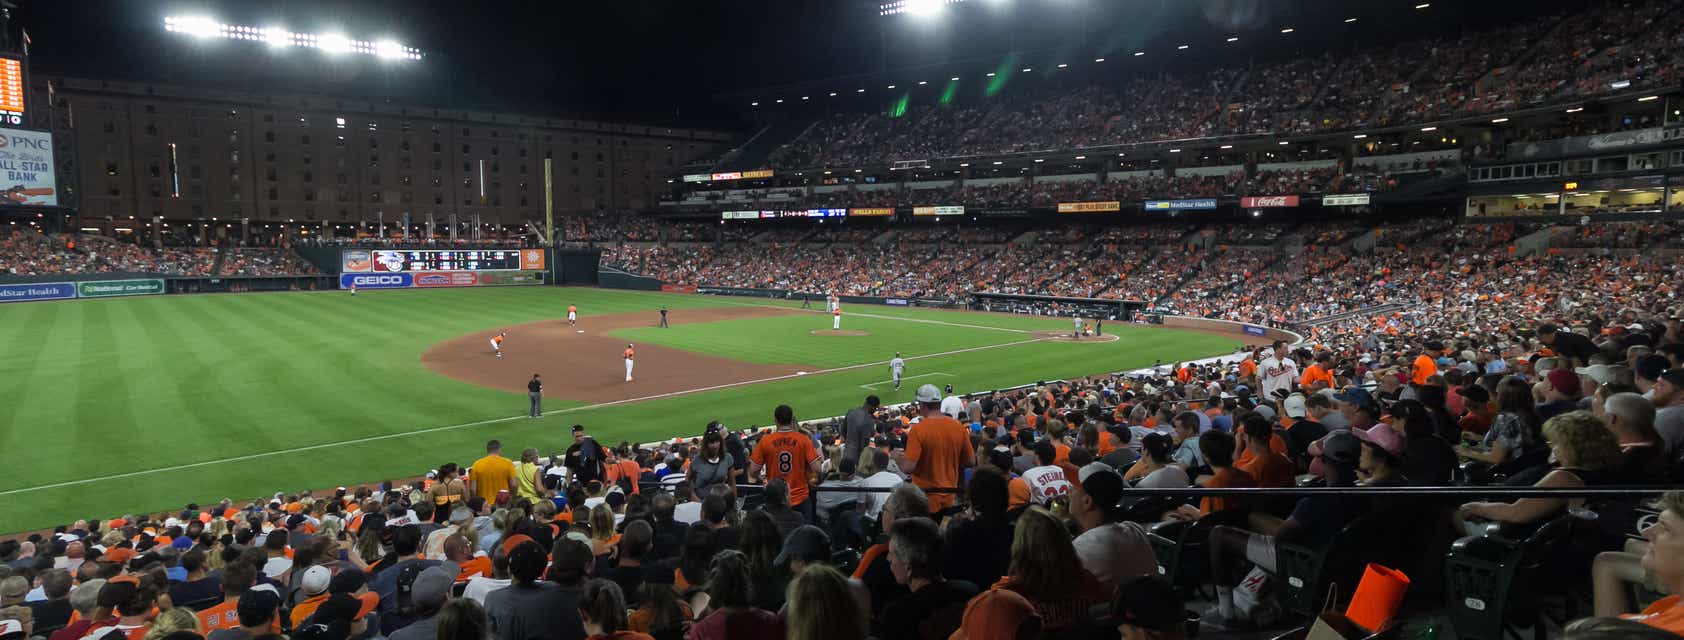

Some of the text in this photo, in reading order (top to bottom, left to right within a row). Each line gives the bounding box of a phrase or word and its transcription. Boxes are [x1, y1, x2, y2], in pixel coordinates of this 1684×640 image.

[12, 136, 49, 151] PNC
[8, 171, 37, 182] BANK
[353, 275, 403, 285] GEICO
[28, 288, 59, 297] Health
[779, 451, 793, 474] 8
